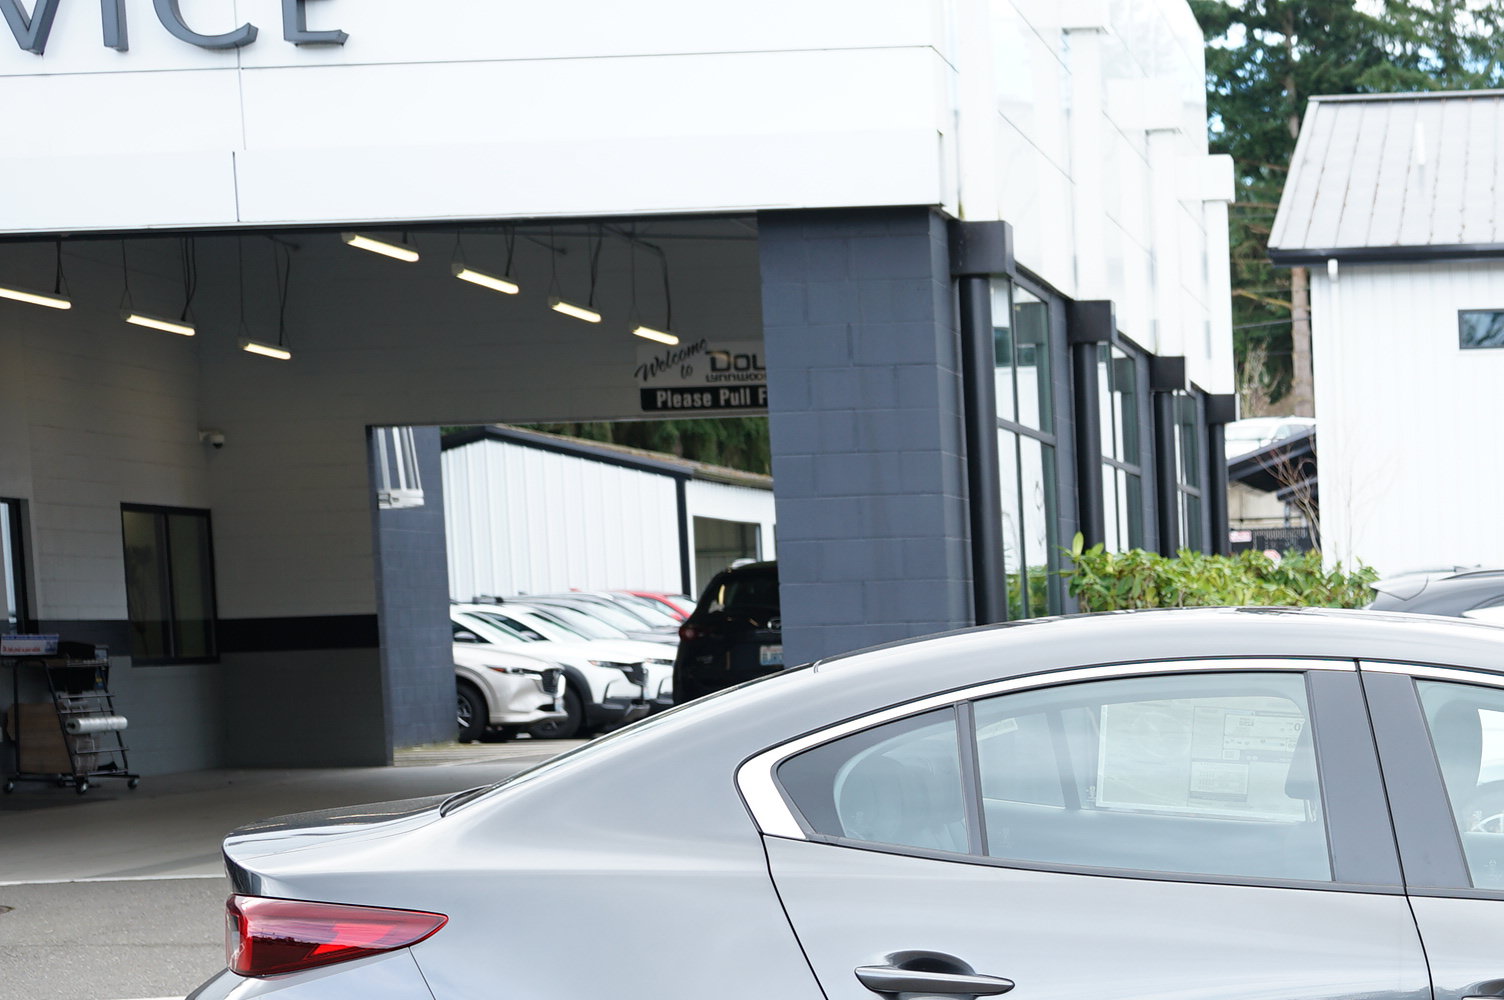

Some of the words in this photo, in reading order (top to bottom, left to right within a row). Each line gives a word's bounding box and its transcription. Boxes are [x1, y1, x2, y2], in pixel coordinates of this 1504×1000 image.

[634, 338, 708, 382] Welcome
[680, 364, 694, 380] to
[656, 389, 713, 409] Please
[719, 387, 751, 406] Pull
